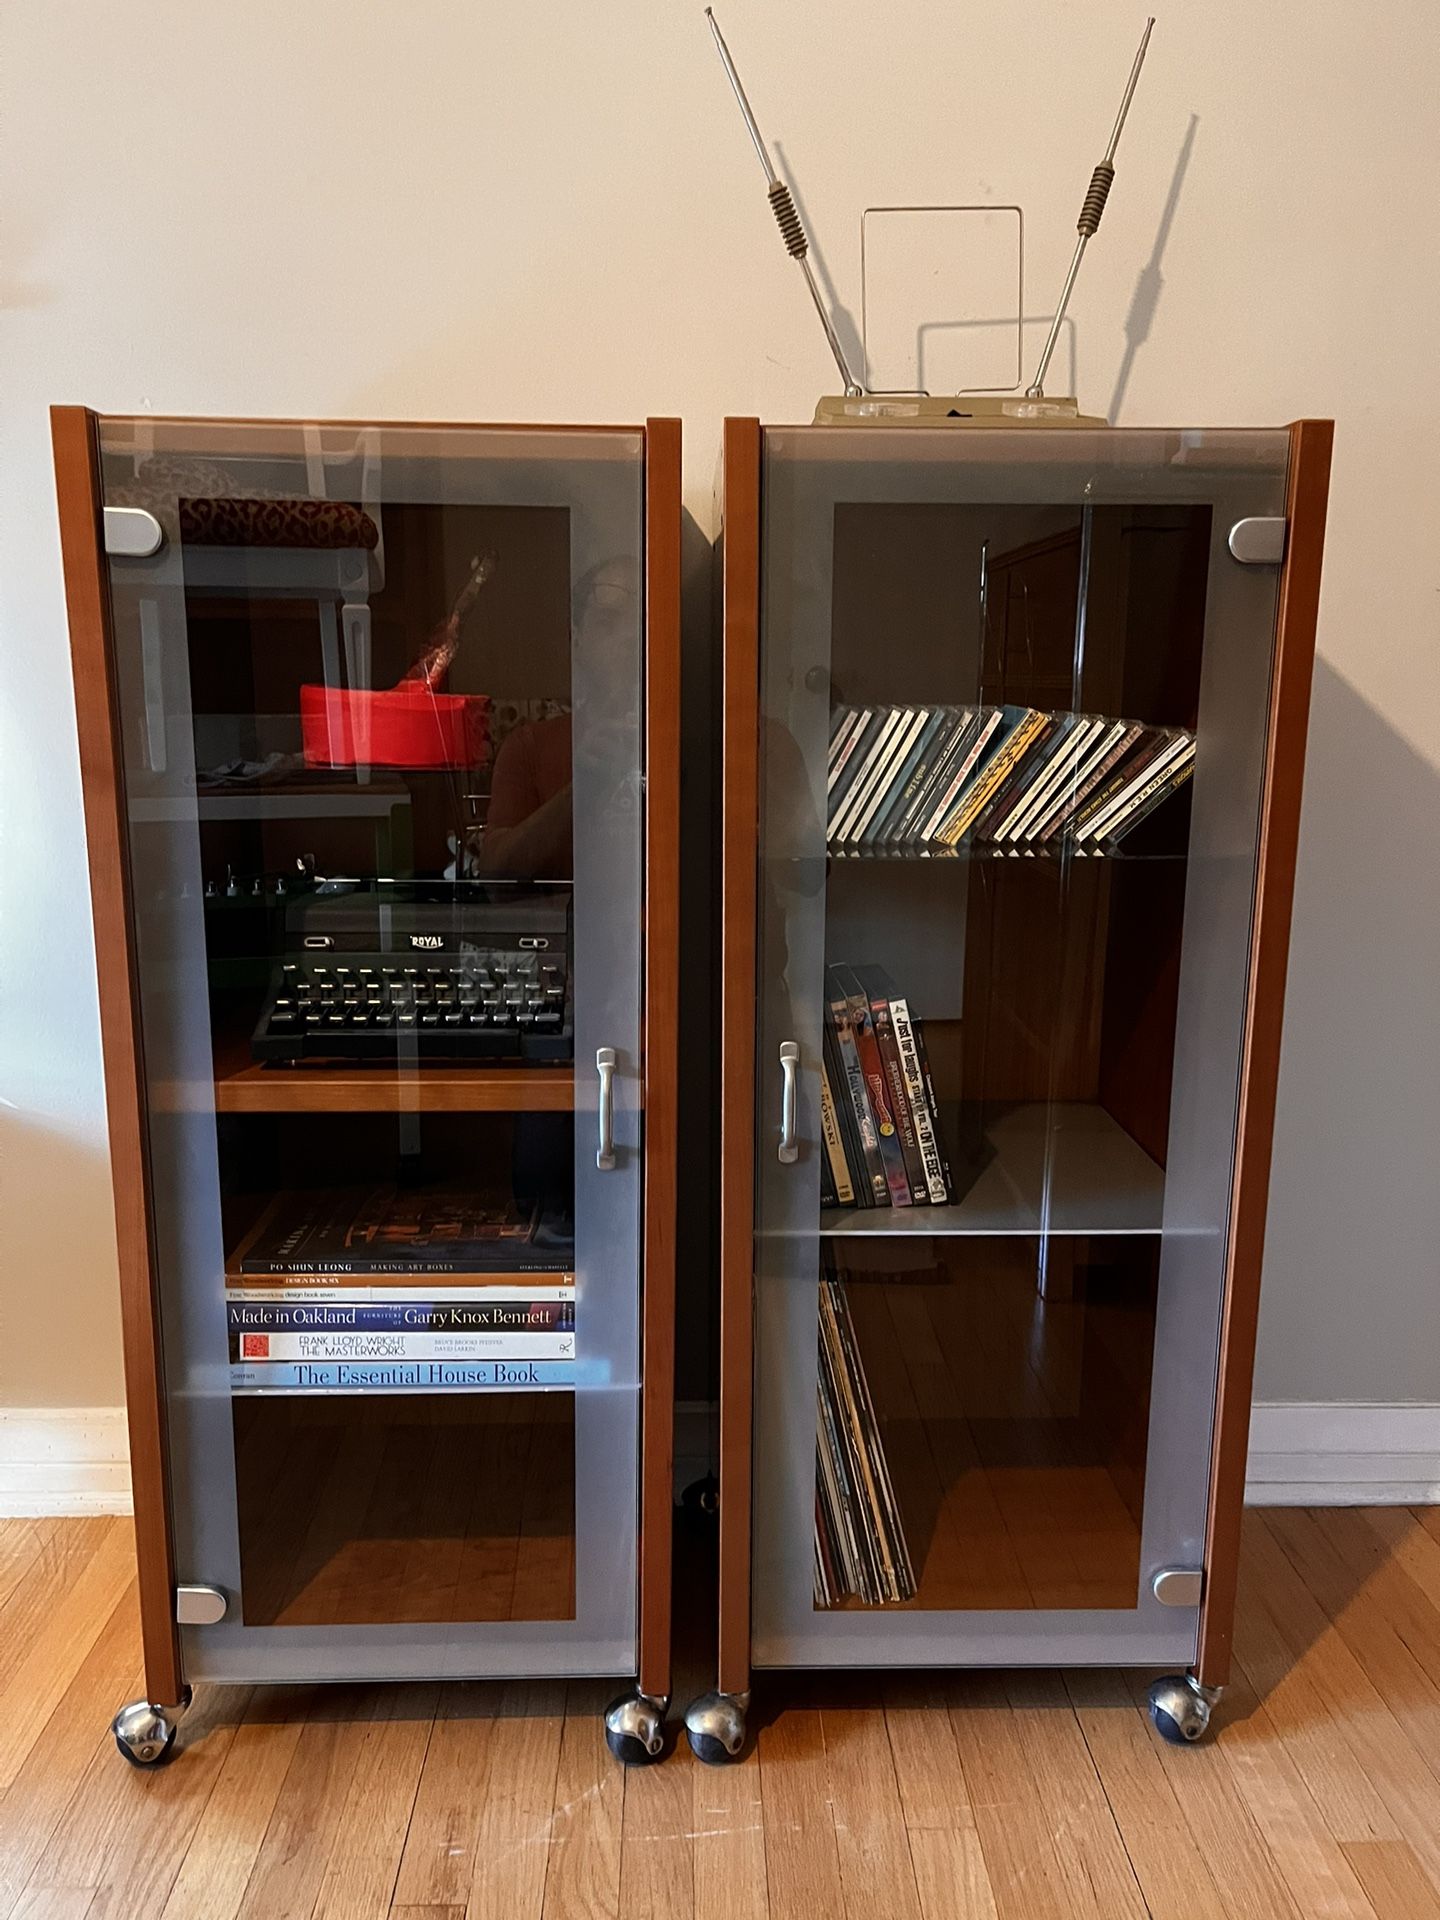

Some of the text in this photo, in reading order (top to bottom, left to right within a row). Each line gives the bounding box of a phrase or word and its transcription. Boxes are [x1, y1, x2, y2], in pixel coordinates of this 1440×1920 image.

[903, 762, 928, 800] sublime
[1147, 766, 1173, 790] GREEN
[410, 936, 444, 949] ROYAL
[895, 1016, 911, 1039] Just
[900, 1038, 913, 1053] for
[902, 1052, 920, 1083] laughs
[821, 1093, 836, 1146] BOWSKI
[919, 1131, 933, 1143] ON
[922, 1143, 936, 1158] THE
[925, 1158, 940, 1178] EDGE
[270, 1263, 284, 1271] PO
[287, 1263, 314, 1272] SHUN
[318, 1263, 352, 1272] LEONG
[285, 1291, 304, 1299] design
[230, 1308, 356, 1324] Made in Oakland
[404, 1308, 448, 1327] Garry
[450, 1308, 490, 1324] Knox
[493, 1308, 552, 1324] Bennett
[299, 1336, 406, 1346] FRANK LLOYD WRIGHT
[300, 1346, 406, 1356] THE MASTERWORKS
[294, 1362, 540, 1384] The Essential House Book
